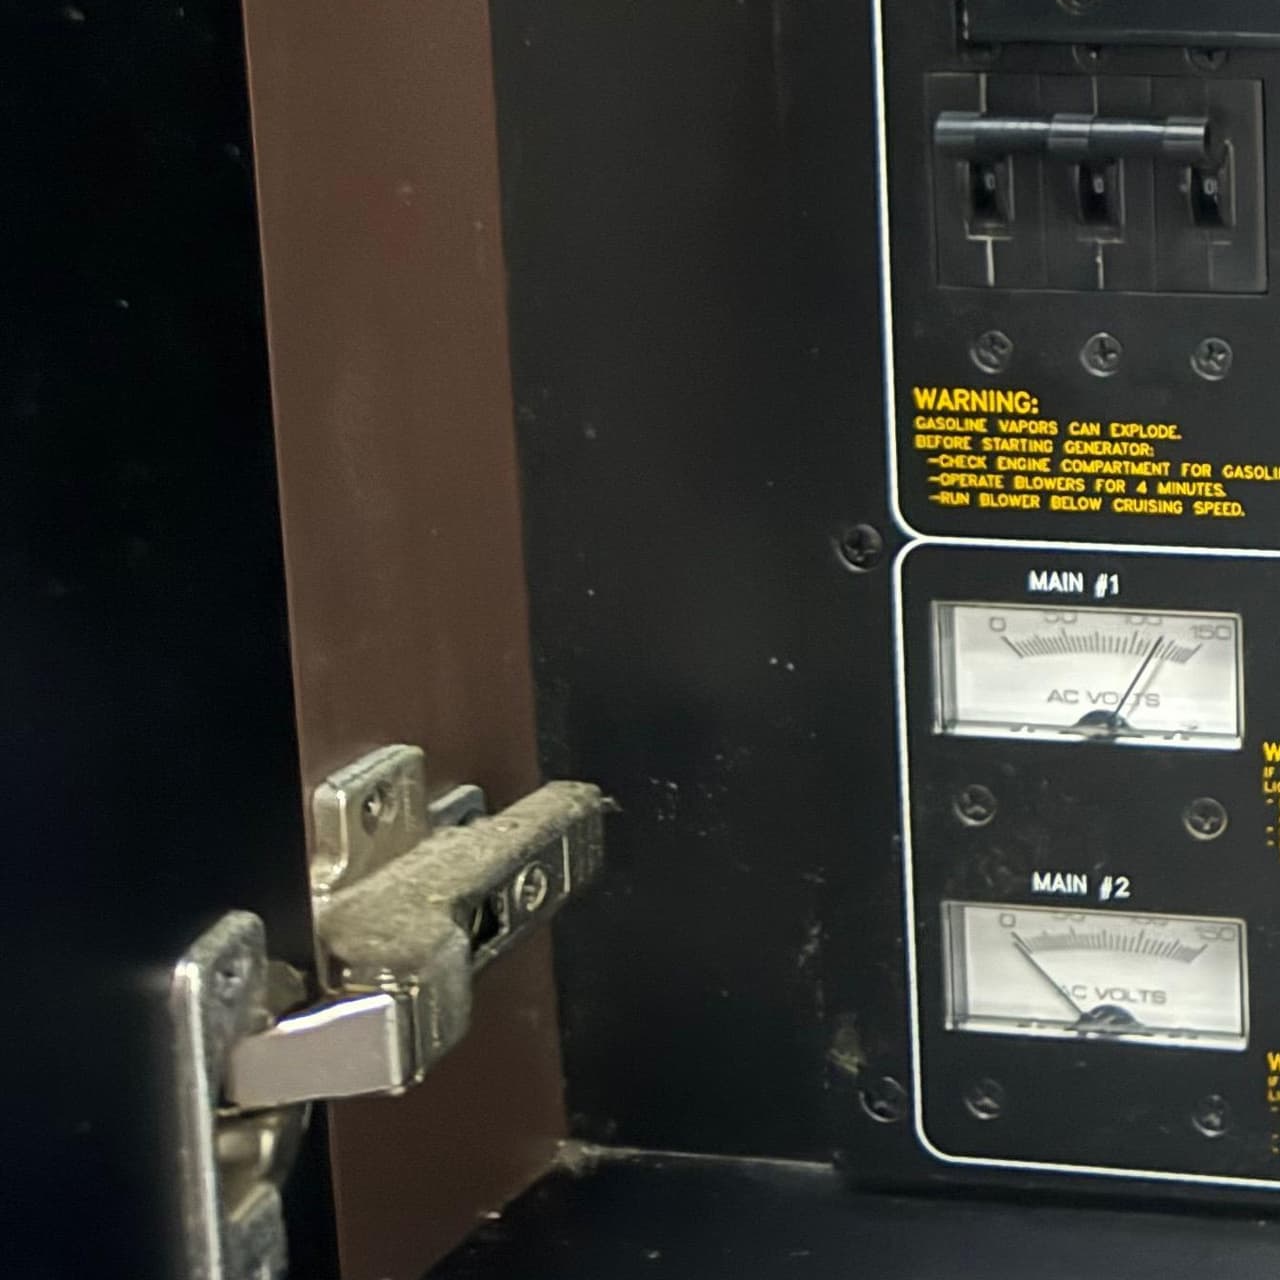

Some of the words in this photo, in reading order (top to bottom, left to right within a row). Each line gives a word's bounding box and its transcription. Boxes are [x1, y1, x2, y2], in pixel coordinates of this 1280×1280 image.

[914, 388, 1038, 414] WARNING:
[915, 416, 987, 432] GASOLINE
[998, 420, 1058, 435] VAPORS
[1069, 422, 1100, 436] CAN
[1110, 423, 1181, 439] EXPLODE.
[915, 435, 972, 450] BEFORE
[982, 437, 1053, 453] STARTING
[1064, 440, 1154, 456] GENERATOR:
[997, 456, 1050, 472] ENGINE
[1060, 459, 1170, 476] COMPARTMENT
[1181, 463, 1211, 477] FOR
[1014, 475, 1085, 492] BLOWERS
[1095, 479, 1125, 493] FOR
[1136, 481, 1147, 494] 4
[979, 493, 1040, 508] BLOWER
[1050, 495, 1102, 510] BELOW
[1113, 498, 1183, 514] CRUISING
[1193, 501, 1245, 516] SPEED.
[1029, 571, 1083, 592] MAIN
[1095, 574, 1118, 598] #1
[1033, 872, 1087, 894] MAIN
[1100, 876, 1130, 900] #2
